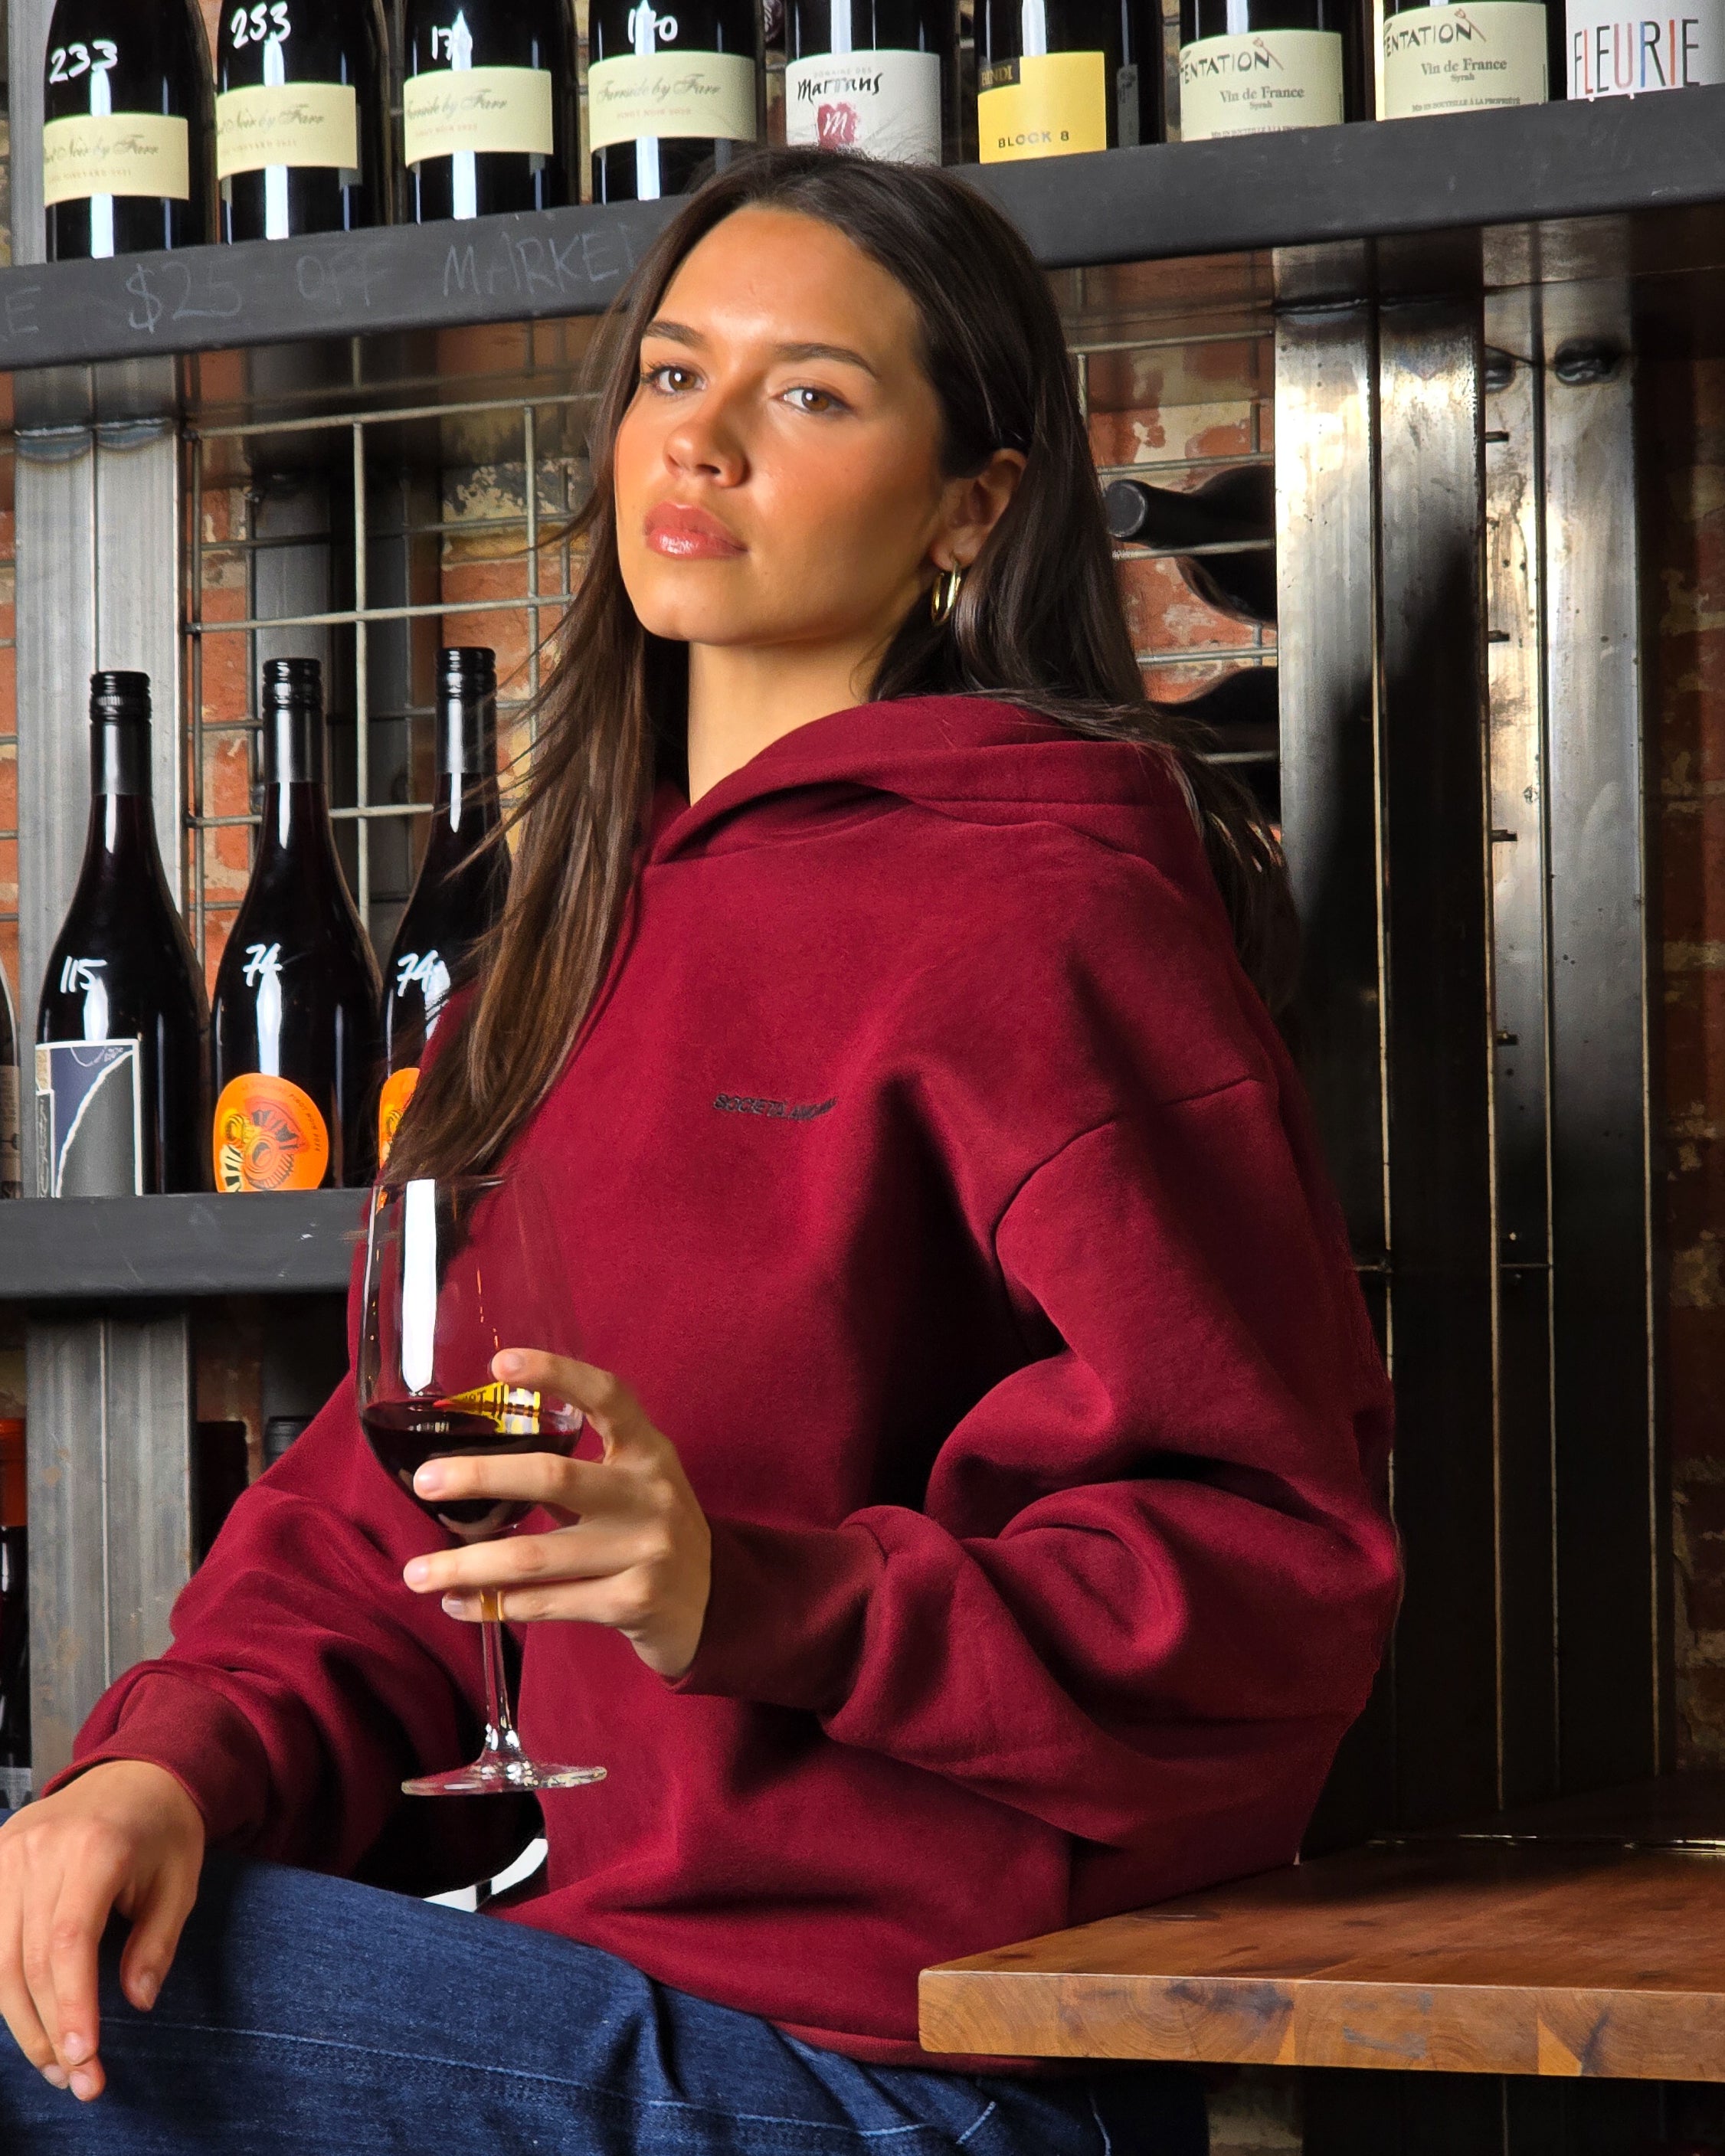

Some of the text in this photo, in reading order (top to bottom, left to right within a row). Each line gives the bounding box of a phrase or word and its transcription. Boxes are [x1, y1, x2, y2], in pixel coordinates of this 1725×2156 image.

[231, 2, 291, 49] 253
[1384, 23, 1471, 57] ENTATION
[49, 40, 118, 84] 233
[1180, 51, 1270, 84] ENTATION
[1421, 58, 1507, 75] Vin de France
[1574, 19, 1700, 98] FLEURIE
[651, 76, 671, 103] by
[673, 74, 722, 95] Farr
[1219, 85, 1304, 103] Vin de France
[1450, 74, 1475, 83] Syrah
[441, 93, 459, 120] by
[998, 130, 1069, 149] BLOCK 8
[125, 260, 243, 333] $25
[61, 956, 107, 993] 115
[397, 950, 439, 997] 74
